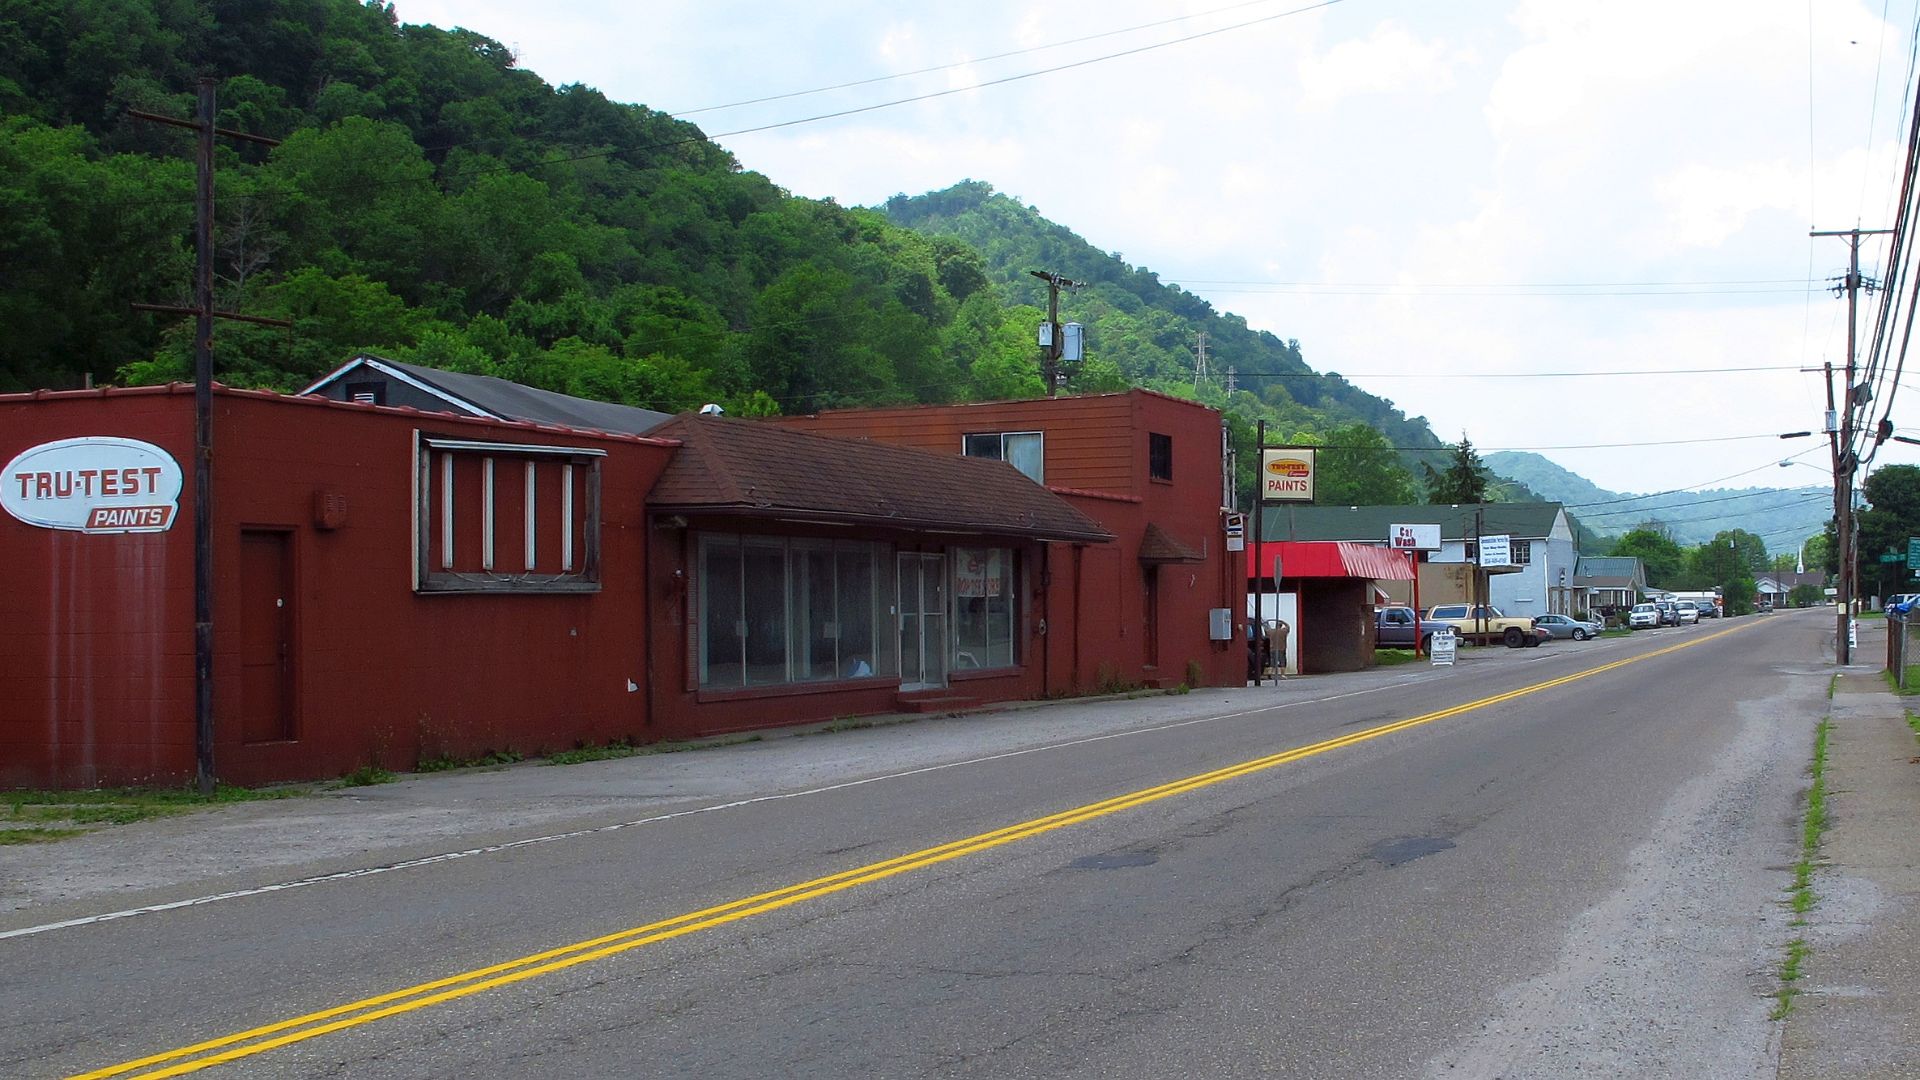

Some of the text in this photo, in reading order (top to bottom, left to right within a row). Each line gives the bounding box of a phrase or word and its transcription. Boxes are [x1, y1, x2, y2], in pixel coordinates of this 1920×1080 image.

[1268, 480, 1307, 491] PAINTS
[94, 508, 162, 526] PAINTS
[1399, 527, 1413, 536] Car
[1395, 537, 1416, 547] Wash
